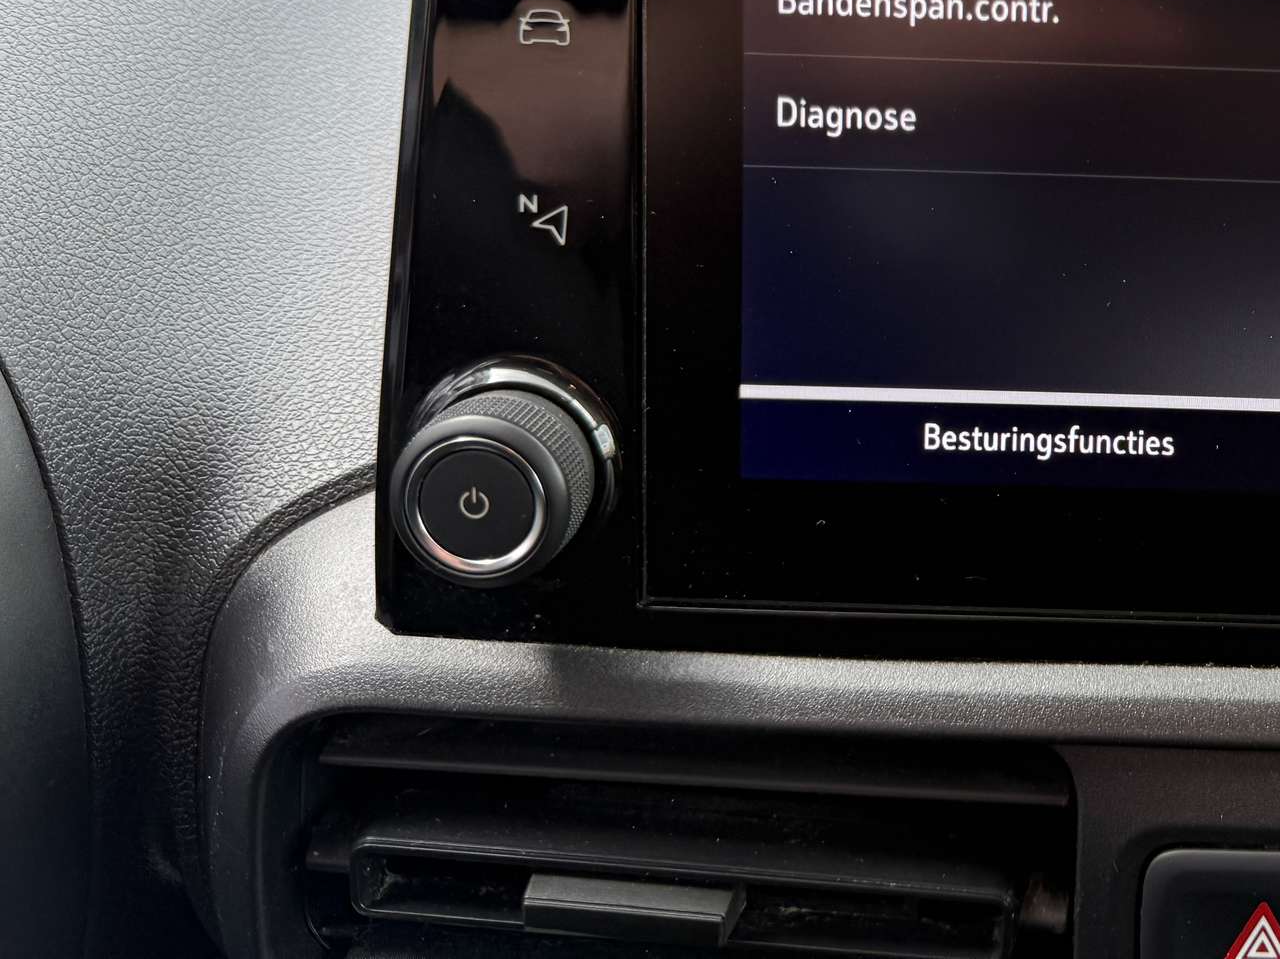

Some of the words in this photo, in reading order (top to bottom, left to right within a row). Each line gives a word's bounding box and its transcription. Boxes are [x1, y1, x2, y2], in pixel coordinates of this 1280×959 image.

[775, 95, 918, 139] Diagnose
[517, 192, 539, 214] N
[922, 421, 1176, 461] Besturingsfuncties
